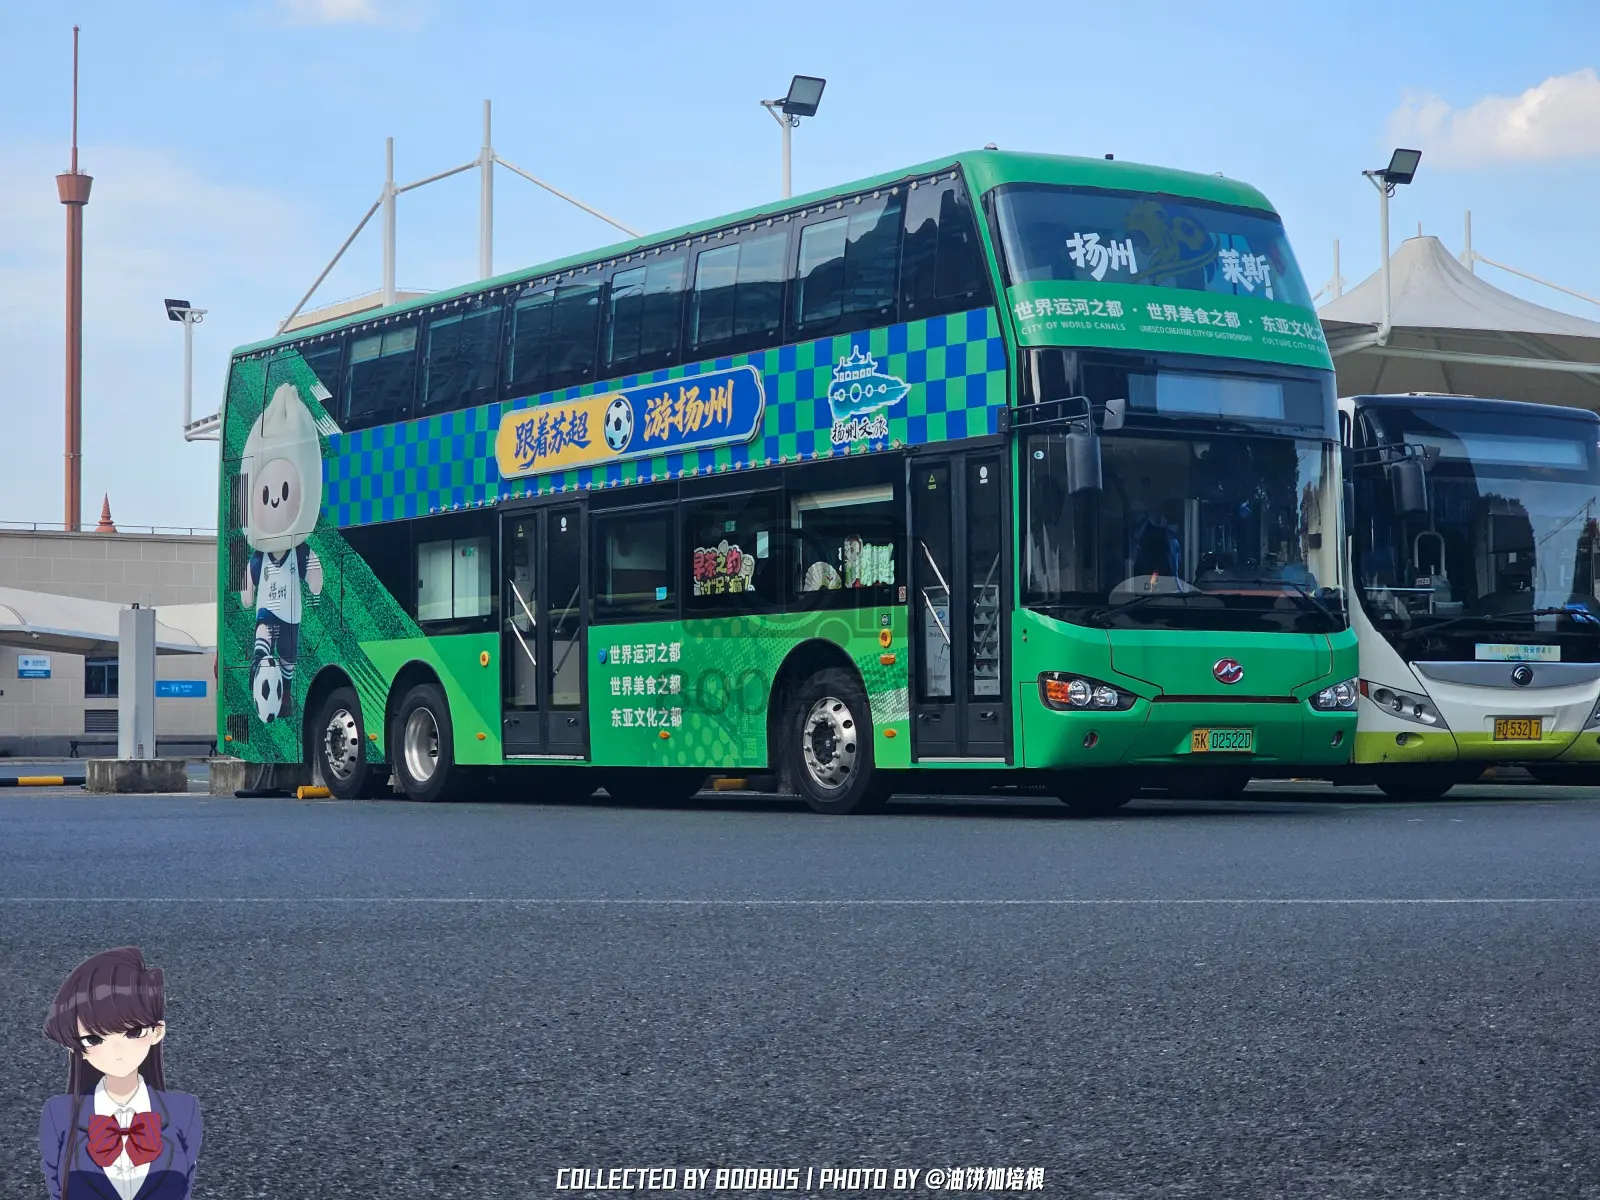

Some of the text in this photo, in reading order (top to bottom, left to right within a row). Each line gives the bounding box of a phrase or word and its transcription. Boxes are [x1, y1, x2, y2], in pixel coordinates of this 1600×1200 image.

[1066, 232, 1138, 282] 扬州
[1218, 249, 1274, 301] 莱斯
[1013, 297, 1124, 321] 世界运河之都
[1146, 302, 1241, 329] 世界美食之都
[1021, 321, 1126, 335] CITY OF WORLD CANALS
[1139, 324, 1165, 335] UNESCO
[1261, 335, 1293, 348] CULTURE
[514, 378, 735, 470] 跟着苏超 游扬州
[831, 415, 888, 443] 扬州文旅
[609, 642, 681, 665] 世界运河之都
[610, 674, 681, 697] 世界美食之都
[611, 706, 682, 729] 东亚文化之都
